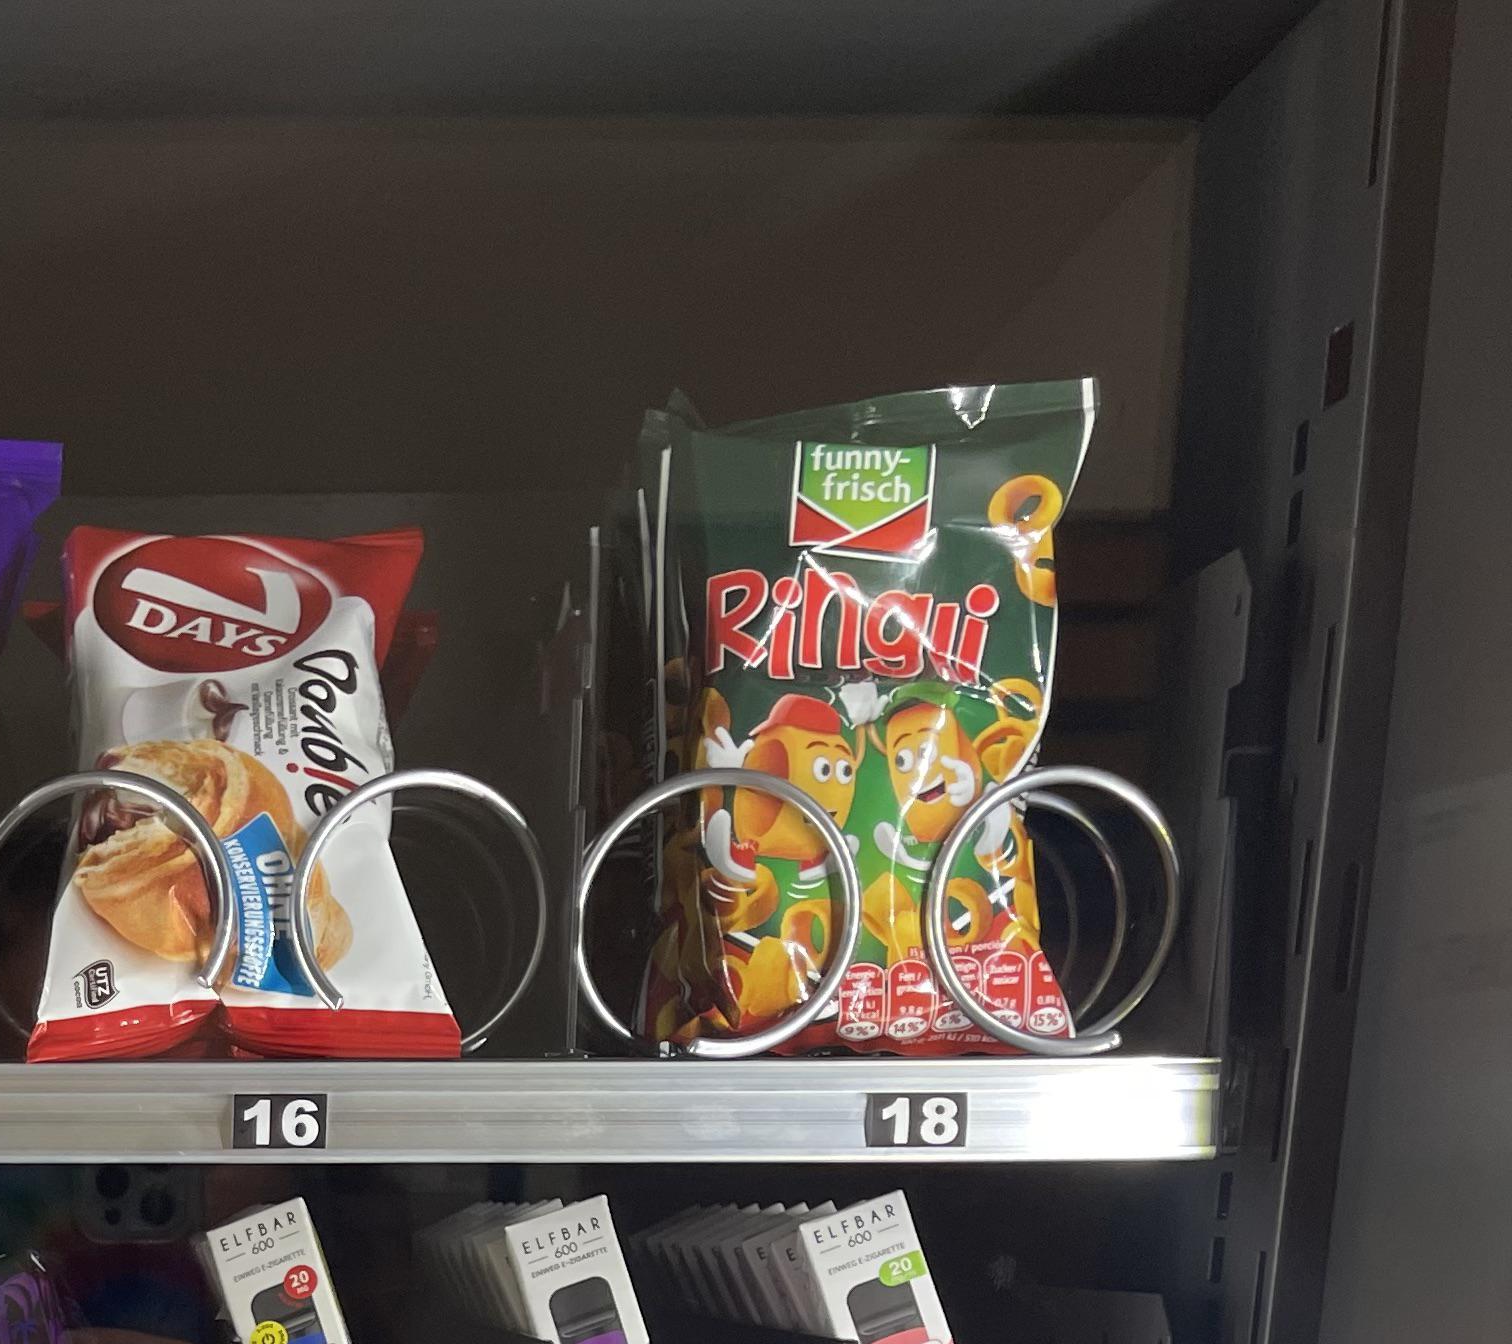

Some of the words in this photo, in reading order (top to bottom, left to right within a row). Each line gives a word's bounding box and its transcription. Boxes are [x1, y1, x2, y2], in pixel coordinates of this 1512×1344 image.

[811, 445, 911, 477] funny-
[822, 473, 911, 502] frisch
[127, 600, 291, 658] DAYS
[95, 967, 110, 996] UTZ
[243, 1099, 319, 1146] 16
[881, 1097, 959, 1145] 18
[220, 1211, 297, 1252] ELFBAR
[522, 1216, 601, 1255] ELFBAR
[814, 1204, 896, 1245] ELFBAR
[847, 1230, 872, 1248] 600
[252, 1237, 275, 1255] 600
[554, 1241, 579, 1259] 600
[289, 1270, 311, 1288] 20
[888, 1257, 913, 1277] 20
